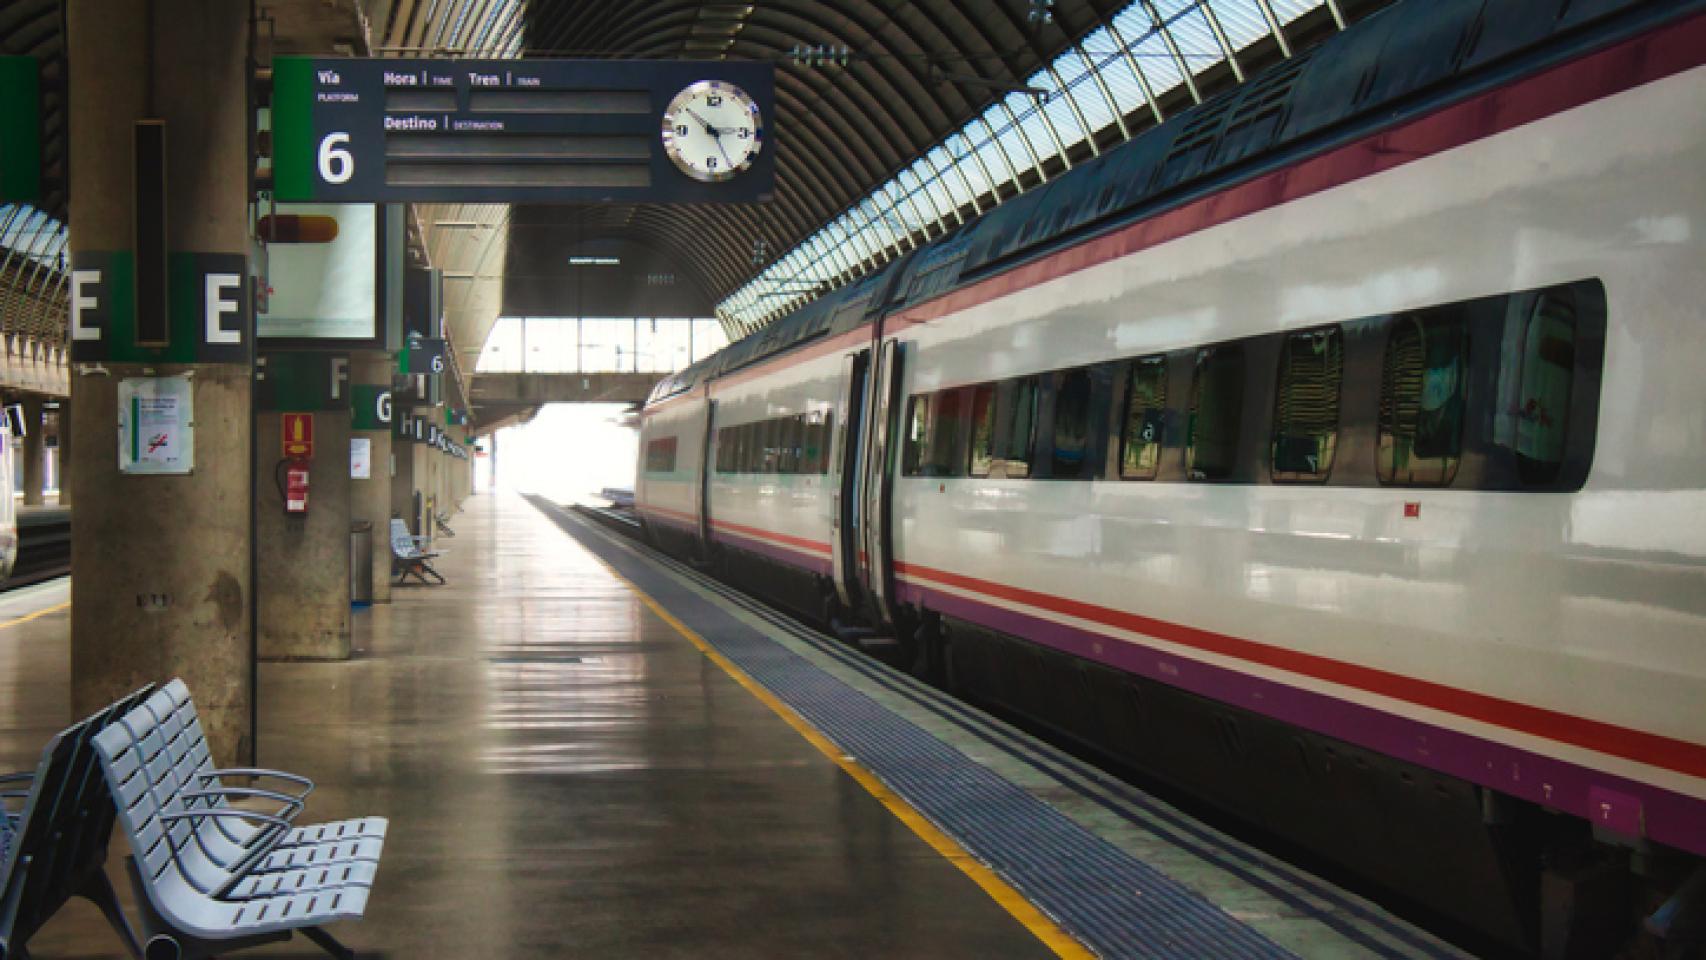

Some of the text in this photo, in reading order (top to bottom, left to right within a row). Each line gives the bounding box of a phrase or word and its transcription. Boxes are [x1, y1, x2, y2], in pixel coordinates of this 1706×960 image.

[384, 71, 418, 86] Hora
[468, 72, 500, 86] Tren
[383, 115, 437, 130] Destino
[317, 131, 355, 184] 6
[72, 271, 101, 341] E
[205, 272, 241, 343] E
[331, 358, 348, 400] F
[432, 355, 443, 373] 6
[378, 392, 391, 422] G
